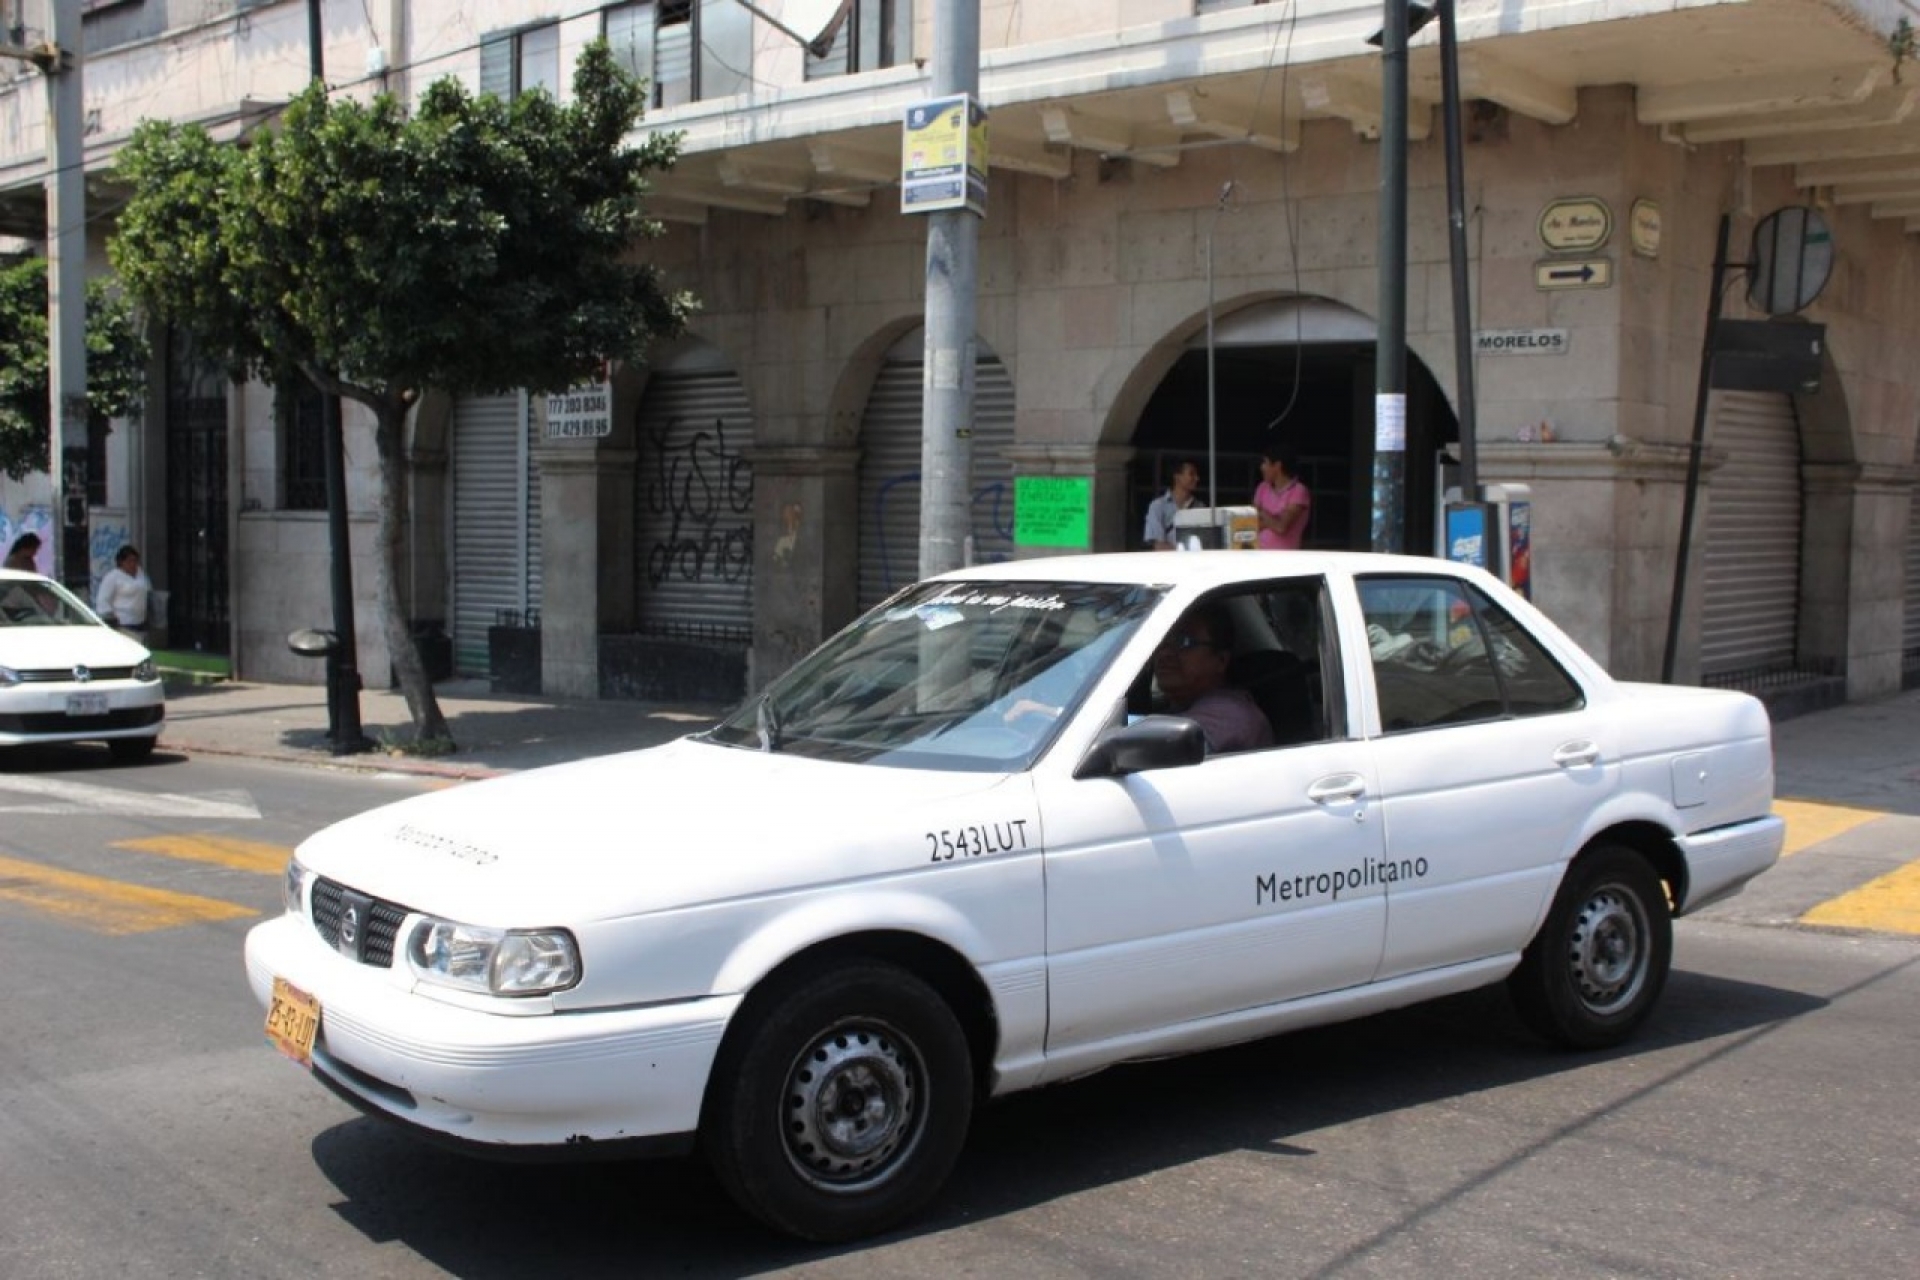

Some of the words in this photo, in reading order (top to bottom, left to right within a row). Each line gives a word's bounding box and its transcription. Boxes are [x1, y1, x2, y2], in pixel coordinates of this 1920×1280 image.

[1479, 334, 1562, 348] MORELOS
[926, 819, 1027, 862] 2543LUT
[1256, 856, 1428, 905] Metropolitano
